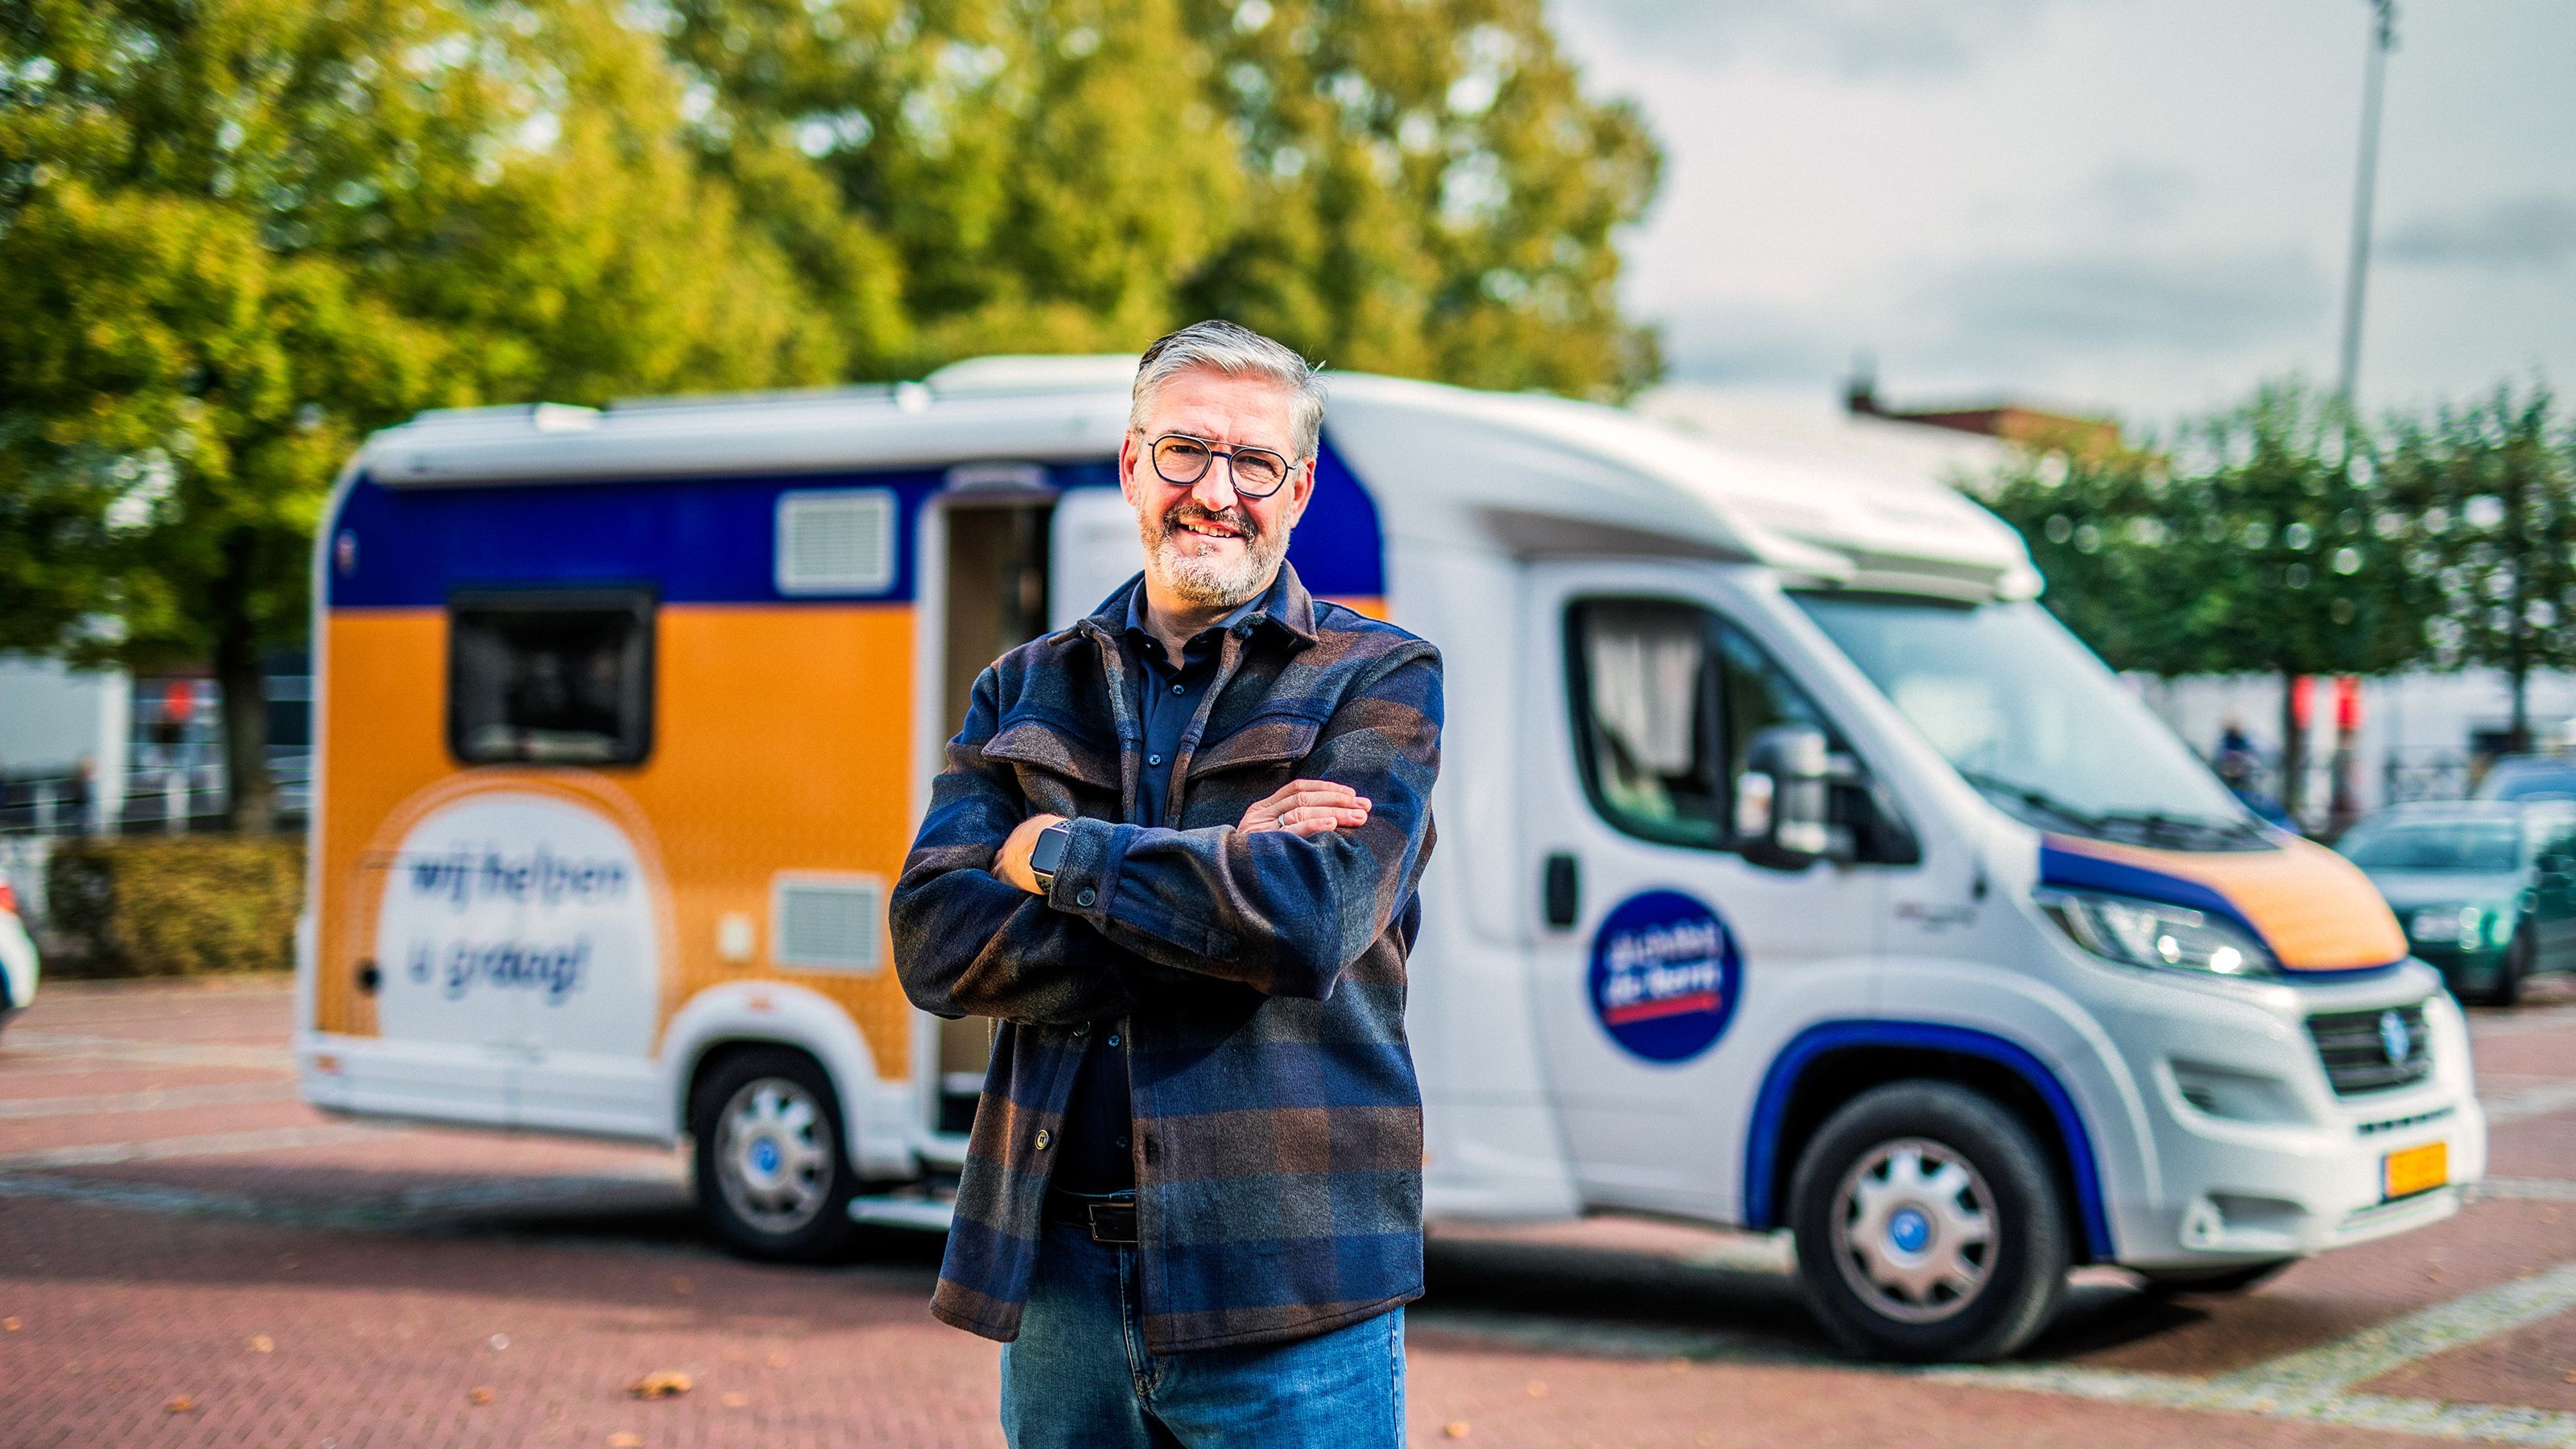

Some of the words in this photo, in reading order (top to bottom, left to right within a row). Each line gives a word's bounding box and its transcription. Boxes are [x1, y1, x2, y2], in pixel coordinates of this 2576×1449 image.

[409, 844, 475, 911] wij
[481, 842, 628, 906] helpen
[408, 944, 433, 983] u
[444, 935, 591, 1004] graag!
